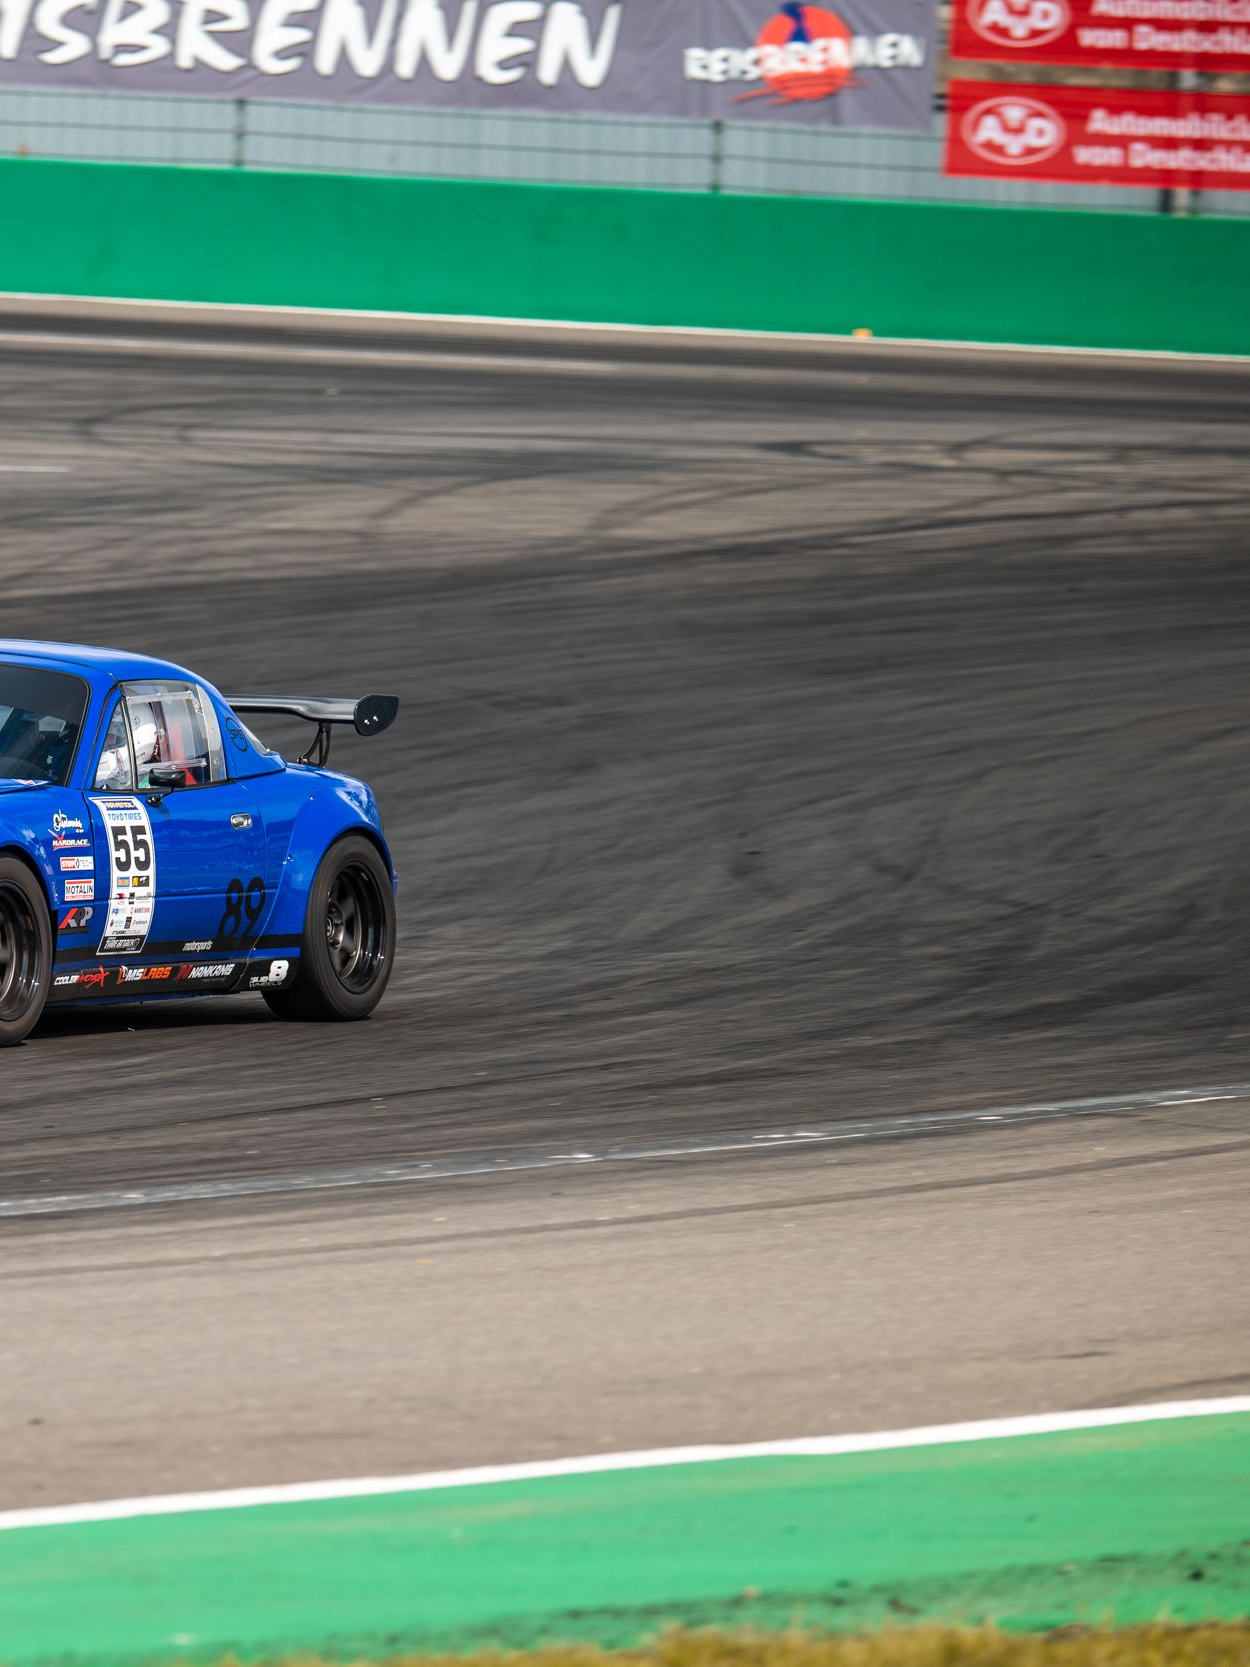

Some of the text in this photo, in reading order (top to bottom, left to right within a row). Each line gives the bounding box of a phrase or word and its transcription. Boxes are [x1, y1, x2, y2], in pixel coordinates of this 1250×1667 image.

[1075, 27, 1130, 49] von
[1071, 146, 1125, 167] von
[108, 812, 142, 821] TOYO TIRES
[110, 825, 151, 872] 55
[65, 885, 93, 895] MOTALIN
[217, 876, 266, 942] 89
[182, 940, 213, 952] motorsports
[188, 964, 235, 979] NANKANG
